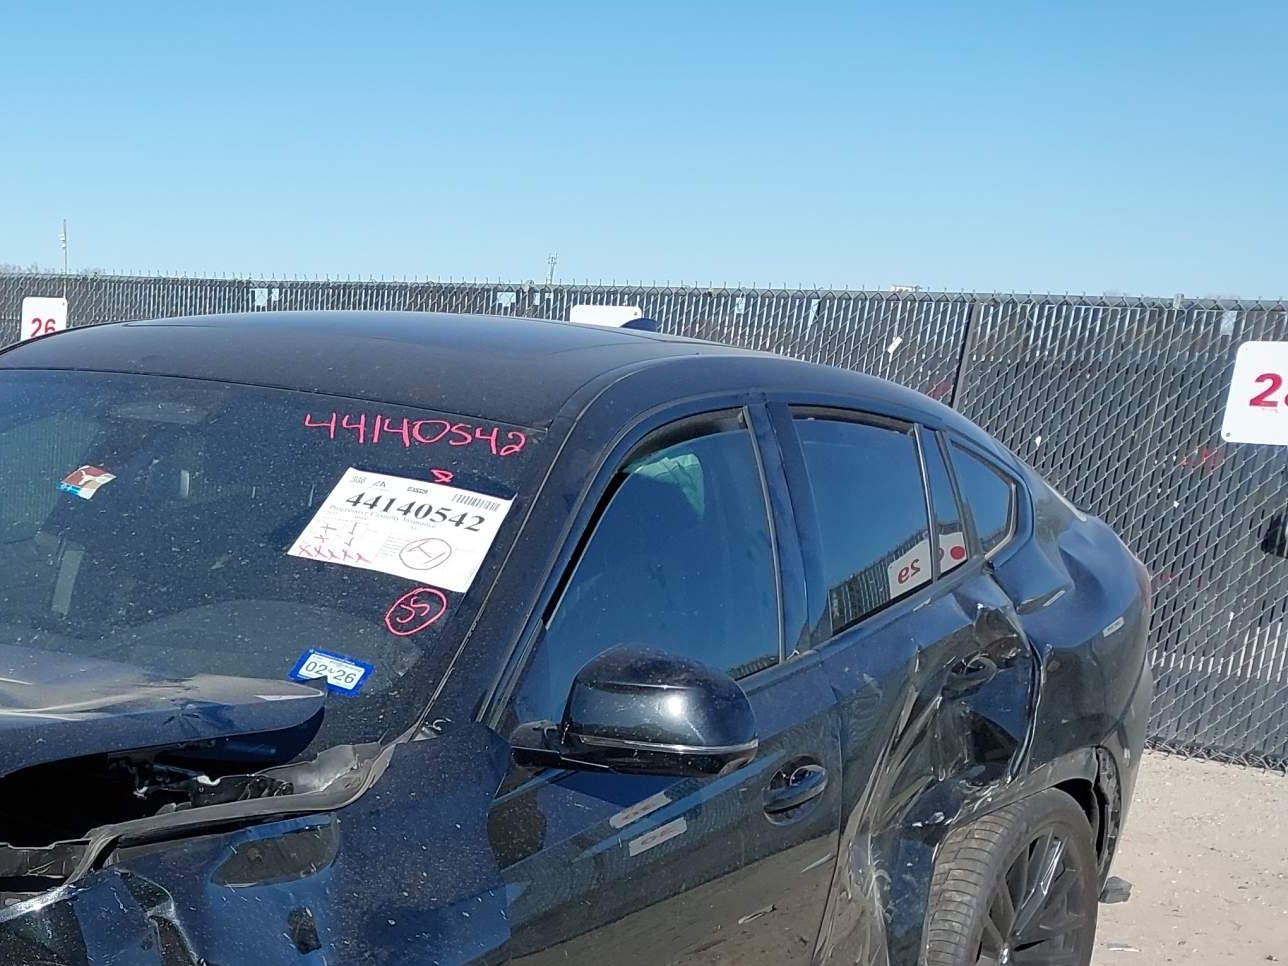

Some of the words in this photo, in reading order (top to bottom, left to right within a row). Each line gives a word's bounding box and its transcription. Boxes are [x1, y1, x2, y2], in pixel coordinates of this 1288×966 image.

[31, 317, 56, 337] 26
[1249, 373, 1288, 408] 2
[303, 412, 527, 456] 44140542
[345, 491, 486, 533] 44140542
[305, 661, 329, 676] 02
[332, 669, 357, 685] 26
